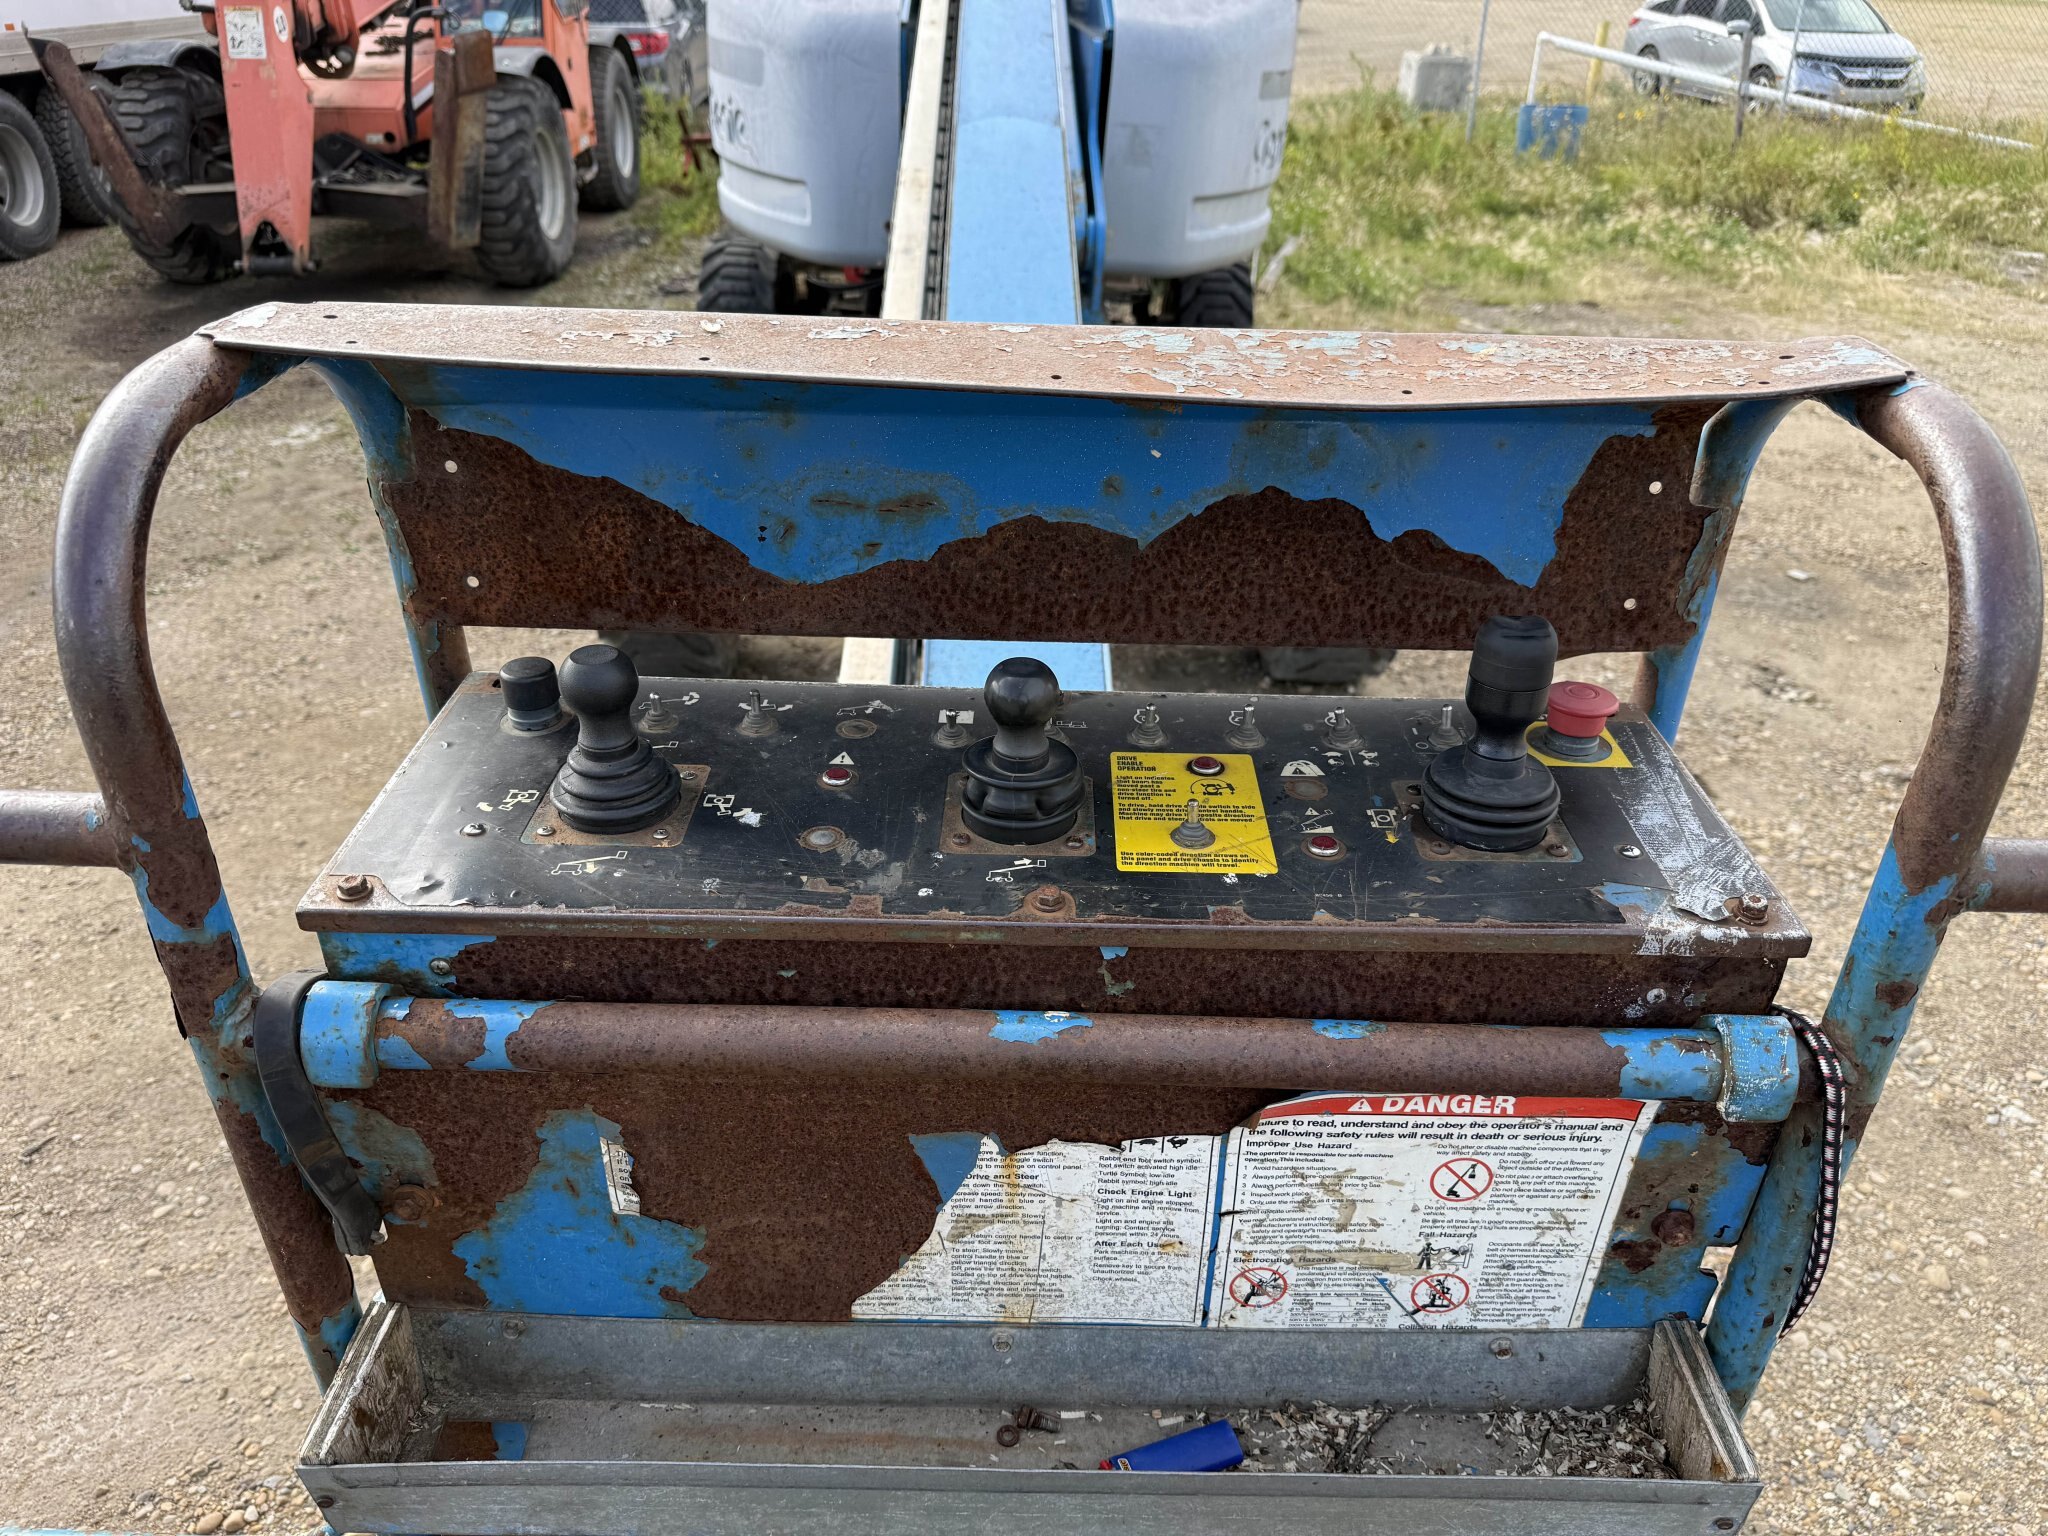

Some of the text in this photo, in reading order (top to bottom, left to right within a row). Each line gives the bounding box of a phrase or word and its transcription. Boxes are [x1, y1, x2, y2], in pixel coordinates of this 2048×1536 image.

[1382, 1095, 1516, 1115] DANGER
[1308, 1120, 1337, 1128] read,
[1341, 1120, 1408, 1128] understand
[1412, 1120, 1434, 1129] and
[1437, 1121, 1467, 1131] obey
[1470, 1120, 1488, 1129] the
[1555, 1123, 1598, 1131] manual
[1601, 1124, 1623, 1132] and
[1270, 1129, 1322, 1138] following
[1398, 1131, 1417, 1139] will
[1420, 1131, 1454, 1140] result
[1457, 1131, 1467, 1140] in
[1471, 1132, 1504, 1140] death
[1523, 1132, 1566, 1142] serious
[1569, 1132, 1602, 1143] injury.
[1246, 1140, 1290, 1149] Improper
